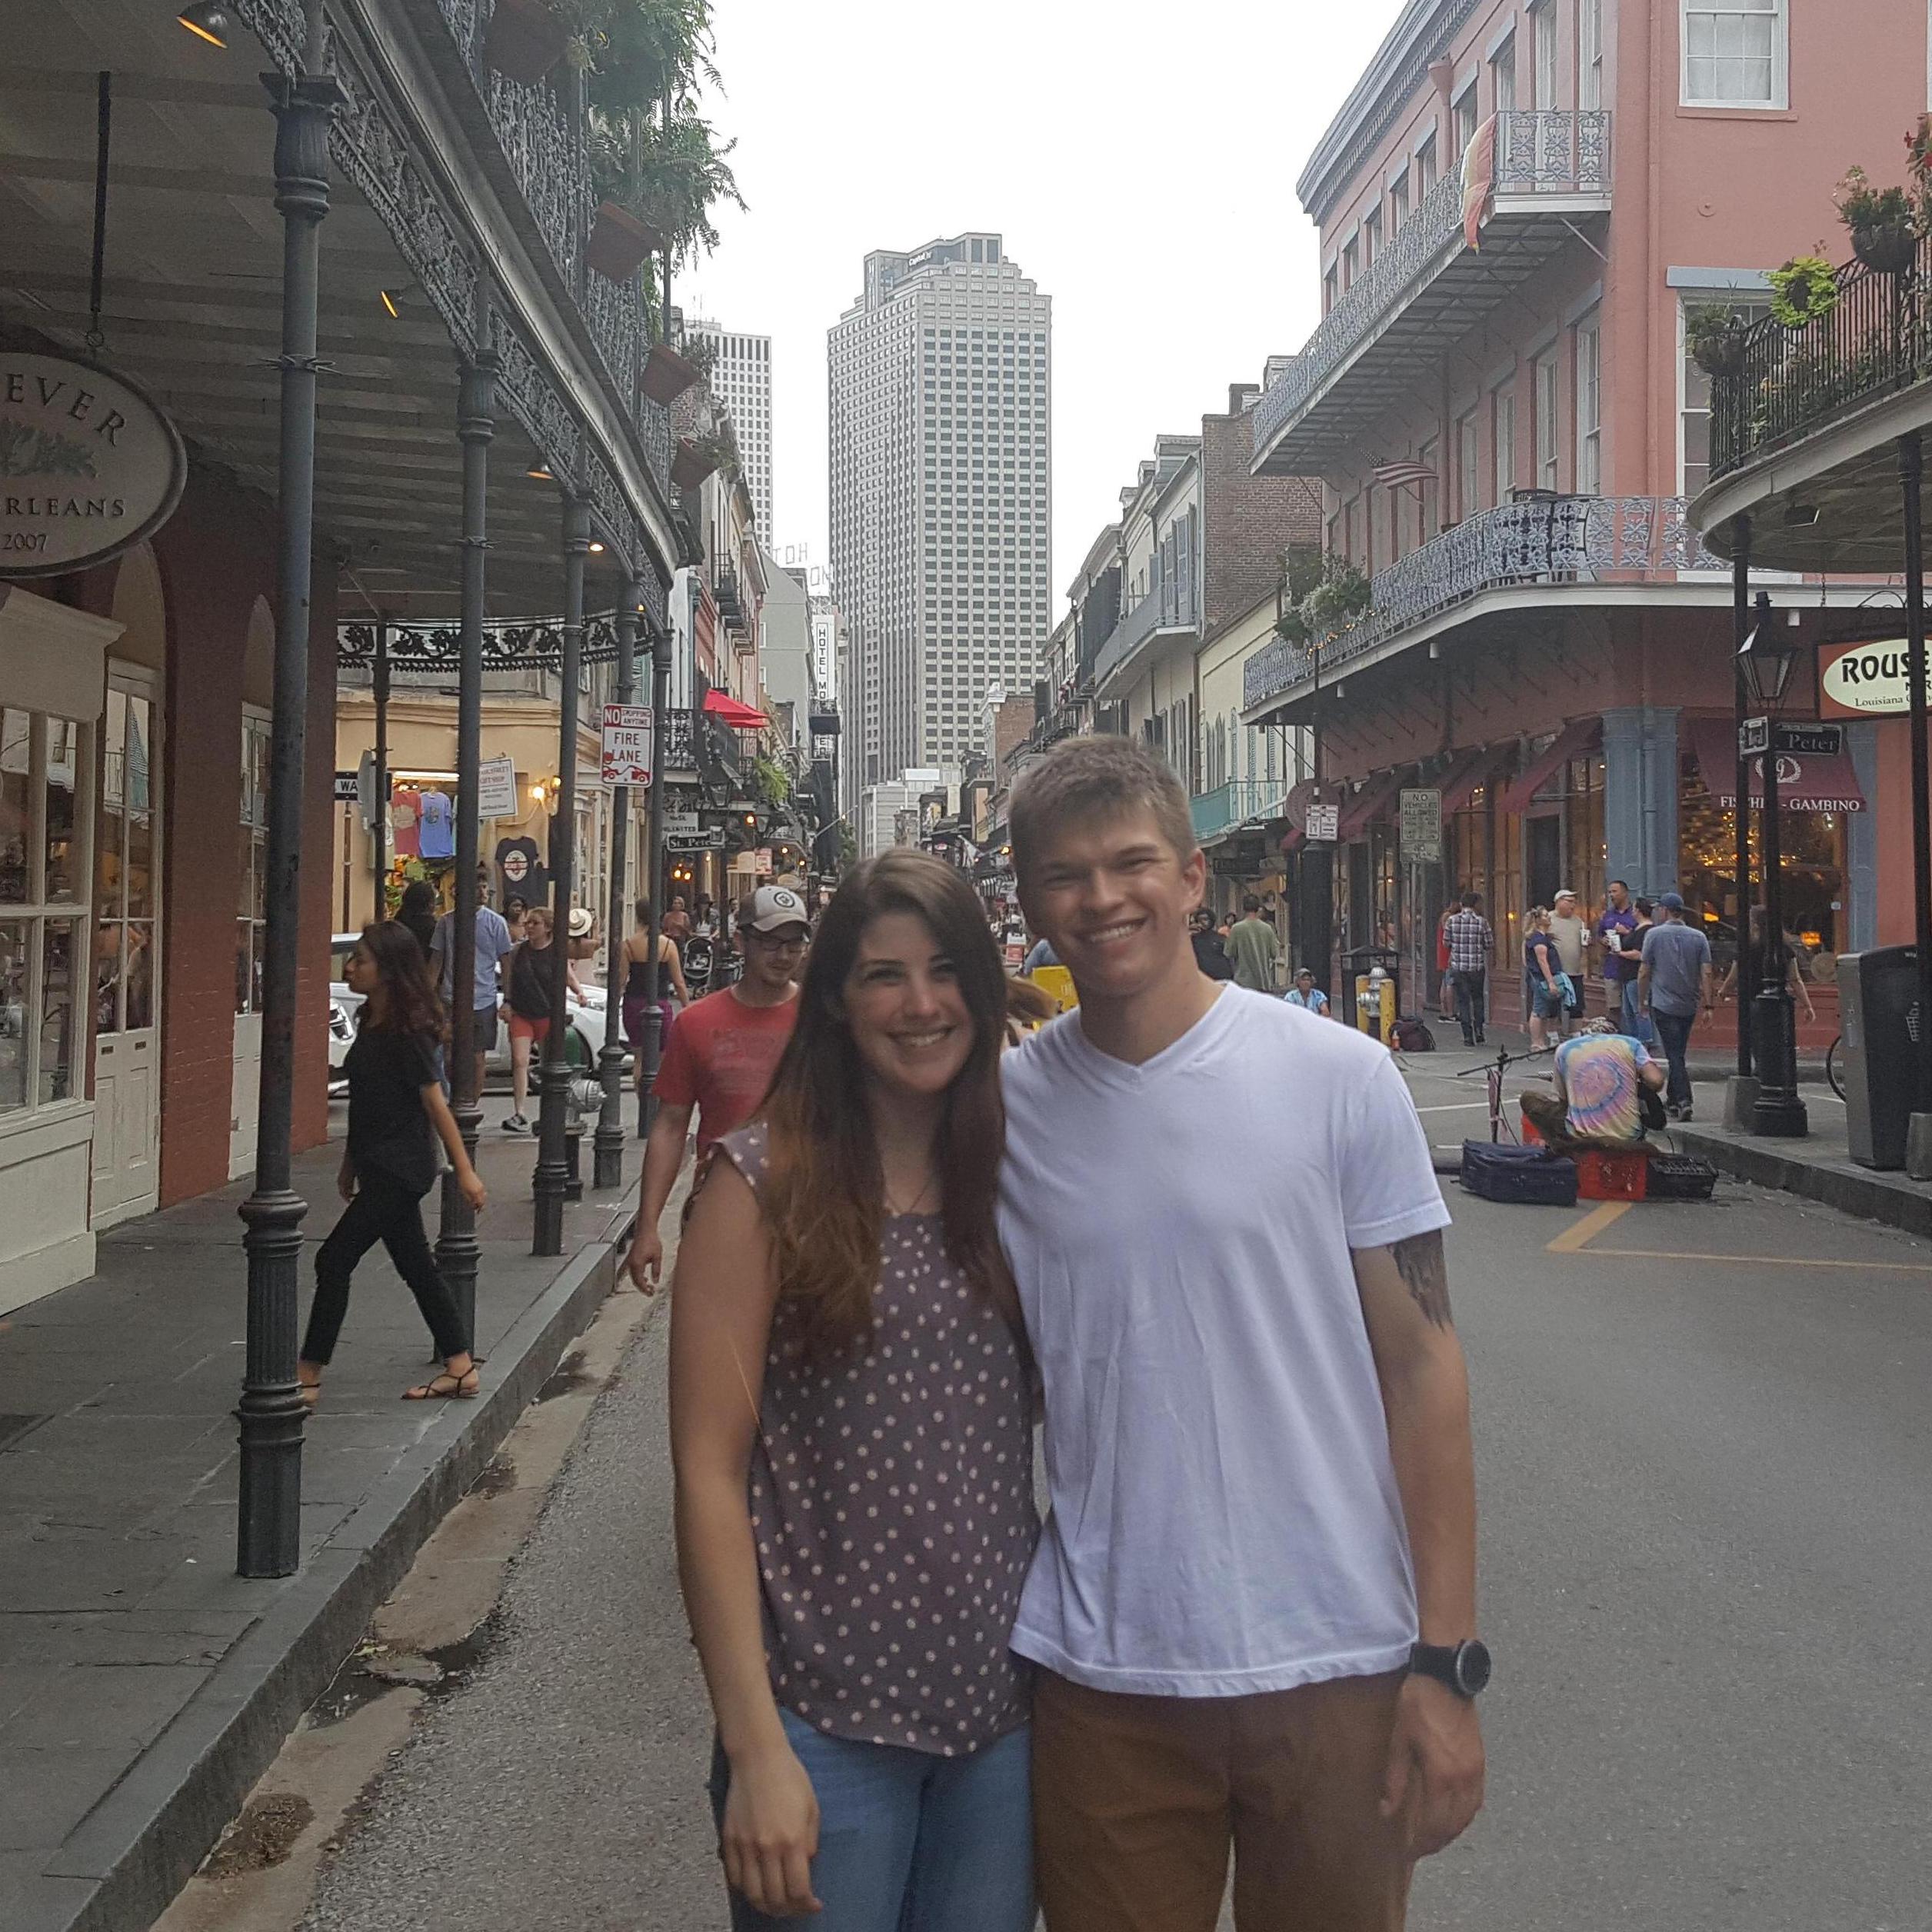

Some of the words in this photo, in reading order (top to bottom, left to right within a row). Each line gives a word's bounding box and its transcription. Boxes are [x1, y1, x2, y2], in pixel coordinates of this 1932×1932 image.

[7, 374, 125, 447] EVER
[6, 498, 125, 518] RLEANS
[1, 533, 47, 554] 2007
[818, 629, 827, 675] HOTEL
[1855, 695, 1904, 707] Louisiana
[605, 708, 621, 724] NO
[615, 732, 640, 746] FIRE
[1789, 733, 1837, 751] Peter
[612, 749, 641, 763] LANE
[341, 780, 358, 792] WA
[1790, 798, 1860, 811] GAMBINO
[688, 837, 711, 847] Pete
